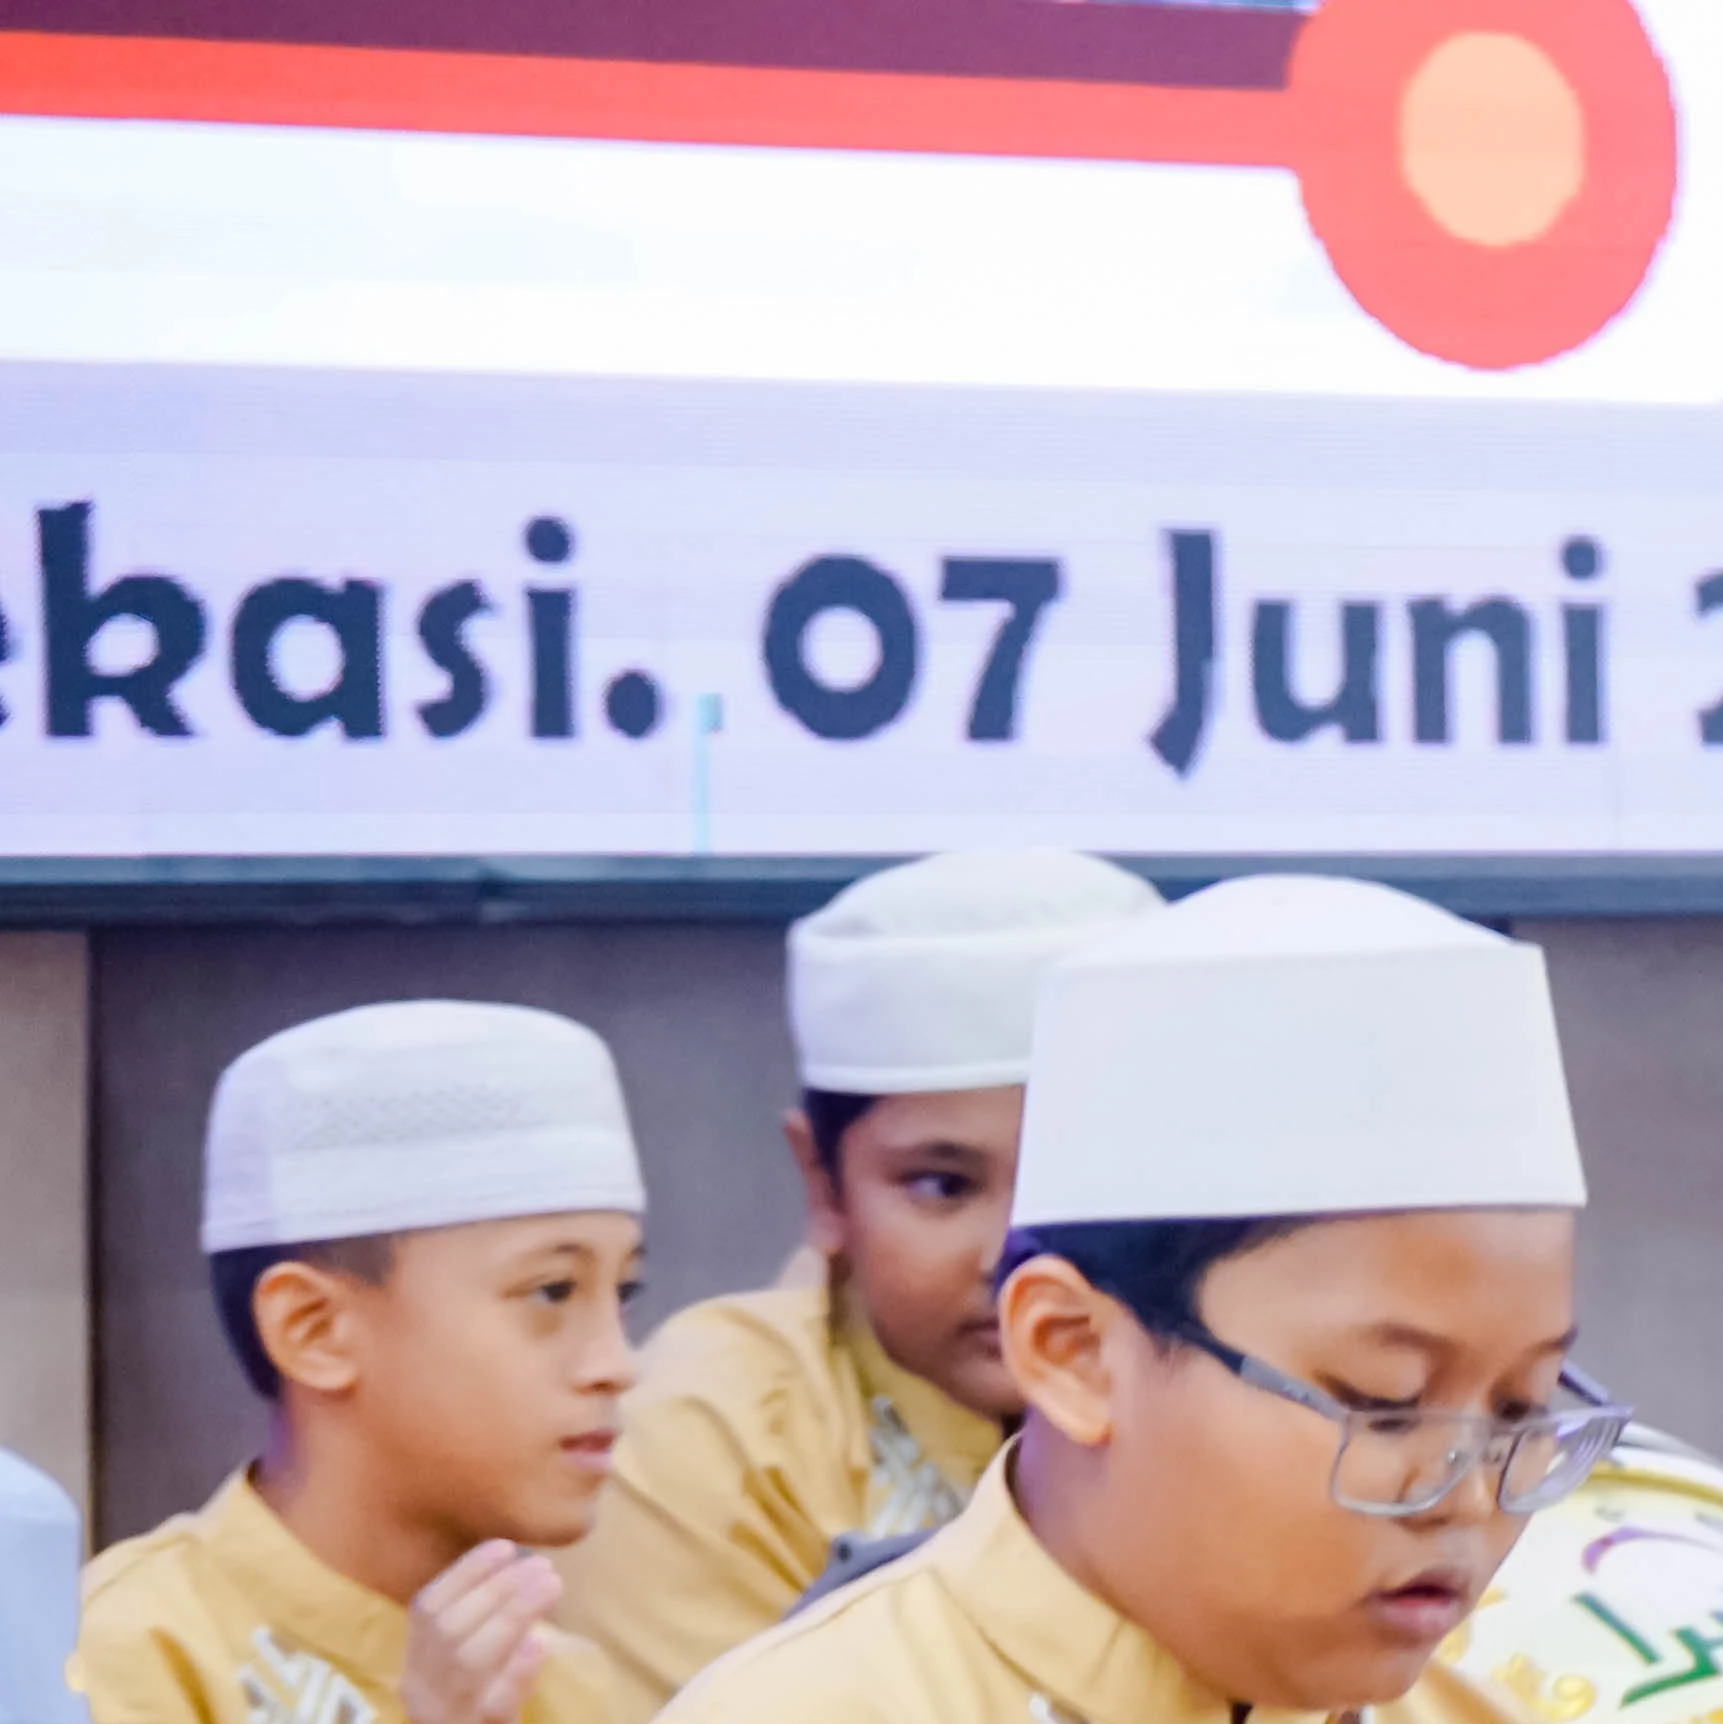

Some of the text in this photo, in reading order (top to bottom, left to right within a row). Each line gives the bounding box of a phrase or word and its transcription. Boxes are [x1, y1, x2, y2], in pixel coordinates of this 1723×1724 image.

[0, 500, 664, 742] kasi.
[760, 553, 1064, 744] 07
[1149, 529, 1604, 777] Juni
